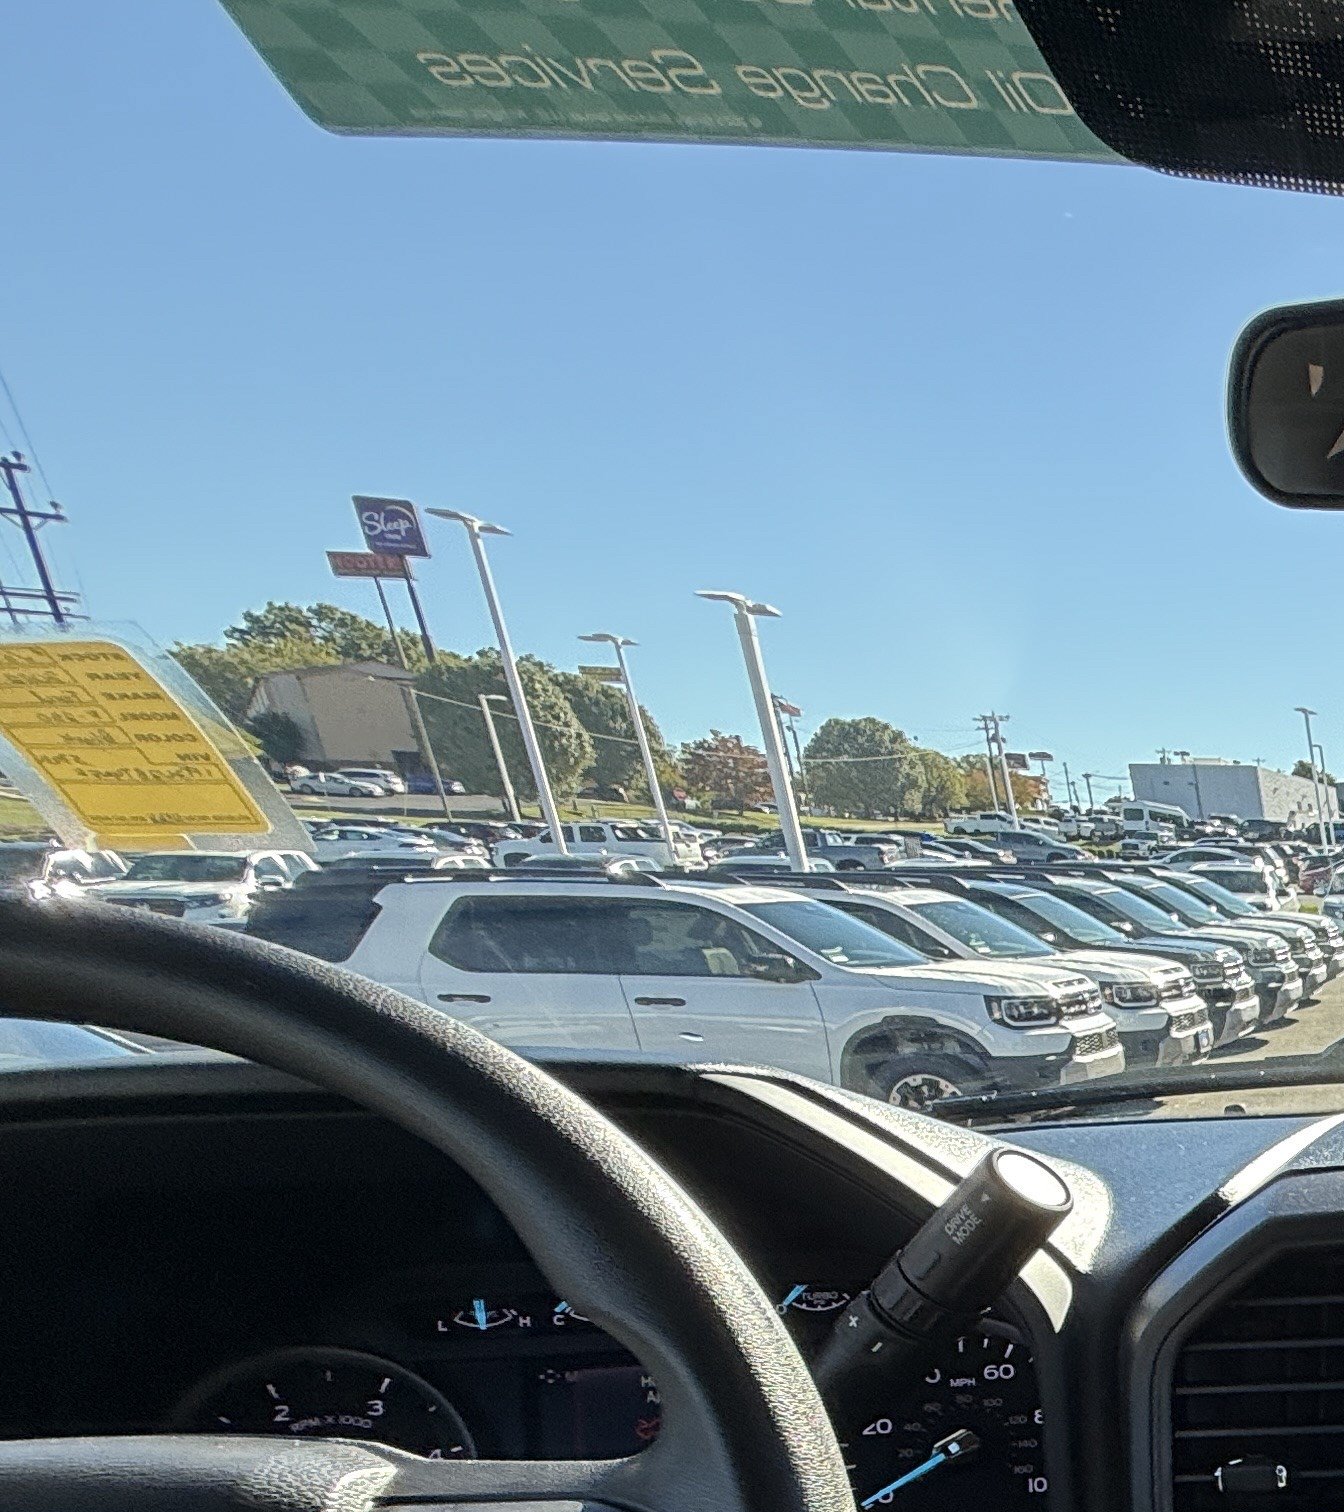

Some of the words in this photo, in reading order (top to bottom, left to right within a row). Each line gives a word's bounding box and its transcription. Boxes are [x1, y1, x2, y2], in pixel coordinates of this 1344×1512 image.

[362, 511, 413, 536] Sleep
[945, 1203, 971, 1236] DRIVE
[952, 1214, 982, 1245] MODE
[518, 1315, 531, 1327] H
[983, 1364, 1015, 1380] 60
[950, 1378, 977, 1388] MPH
[273, 1404, 292, 1421] 2
[367, 1400, 384, 1416] 3
[289, 1416, 320, 1432] RPM
